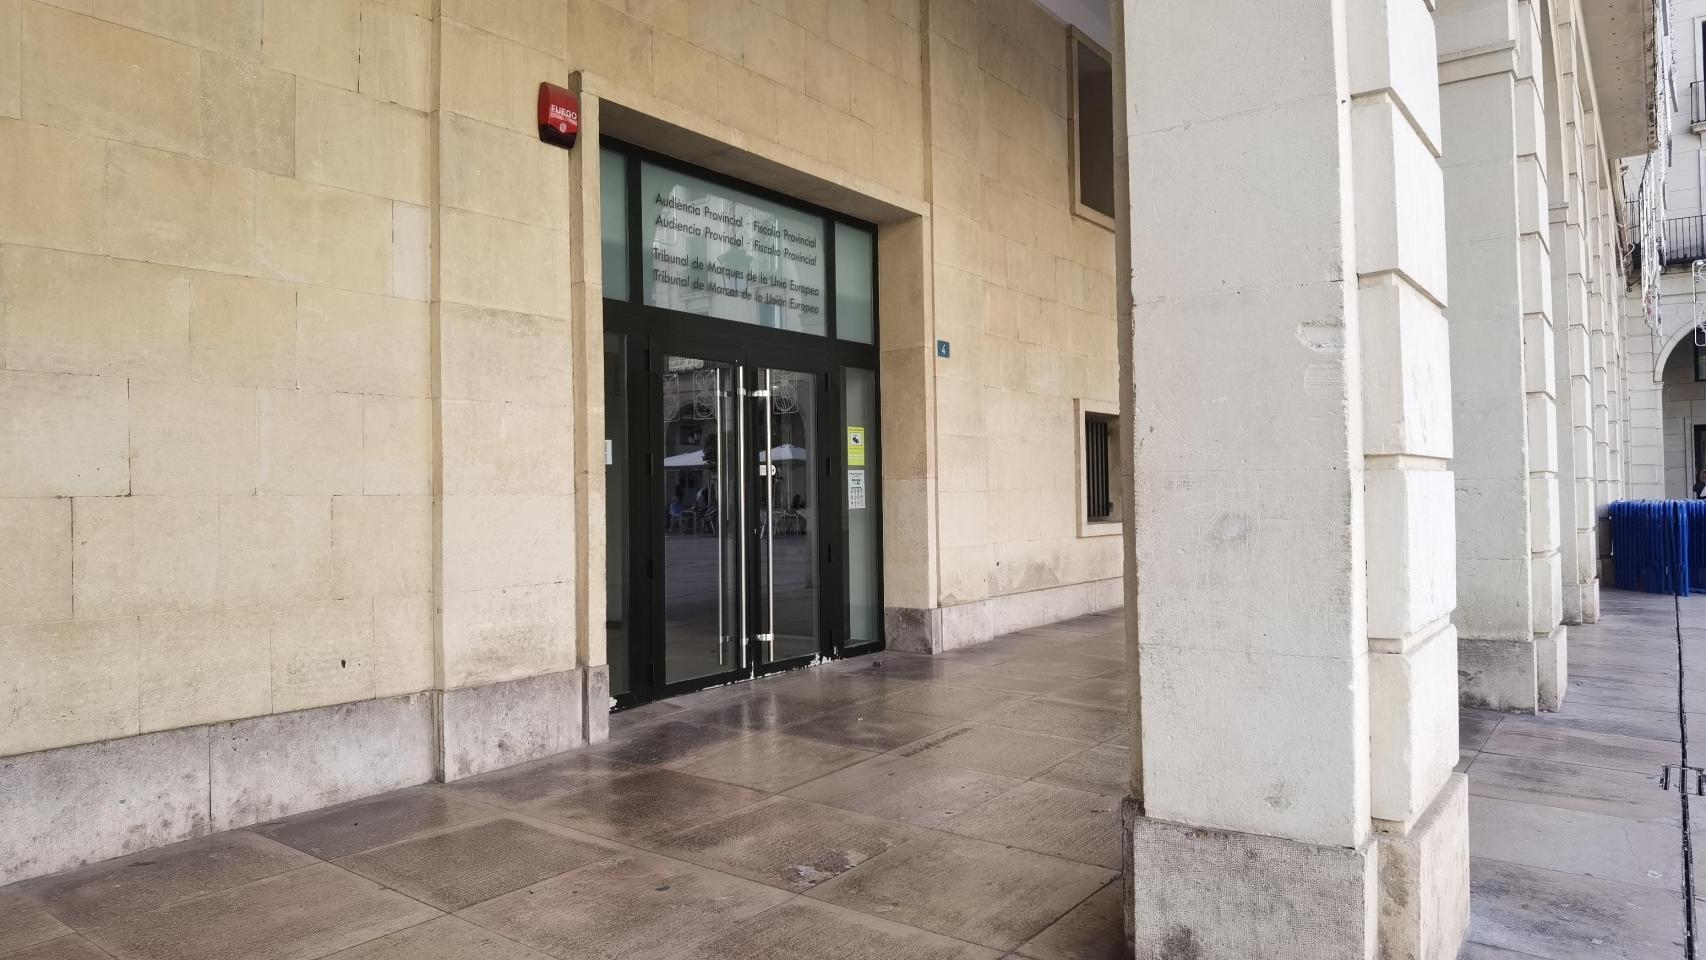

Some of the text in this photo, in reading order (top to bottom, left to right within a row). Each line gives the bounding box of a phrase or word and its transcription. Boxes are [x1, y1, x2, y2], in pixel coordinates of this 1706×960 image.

[551, 104, 577, 120] FUEGO
[655, 214, 701, 236] Audiencia
[705, 226, 744, 247] Provincial
[784, 247, 817, 266] Provincial
[704, 206, 743, 227] Provincial
[783, 229, 817, 248] Provincial
[653, 248, 689, 267] Tribunal
[692, 256, 704, 270] de
[708, 261, 744, 280] Marques
[747, 269, 757, 282] de
[760, 272, 768, 284] la
[790, 279, 820, 297] Europea
[653, 269, 690, 287] Tribunal
[693, 277, 705, 290] de
[709, 280, 739, 297] Marcas
[742, 287, 753, 300] de
[756, 289, 763, 304] la
[789, 298, 819, 314] Europea
